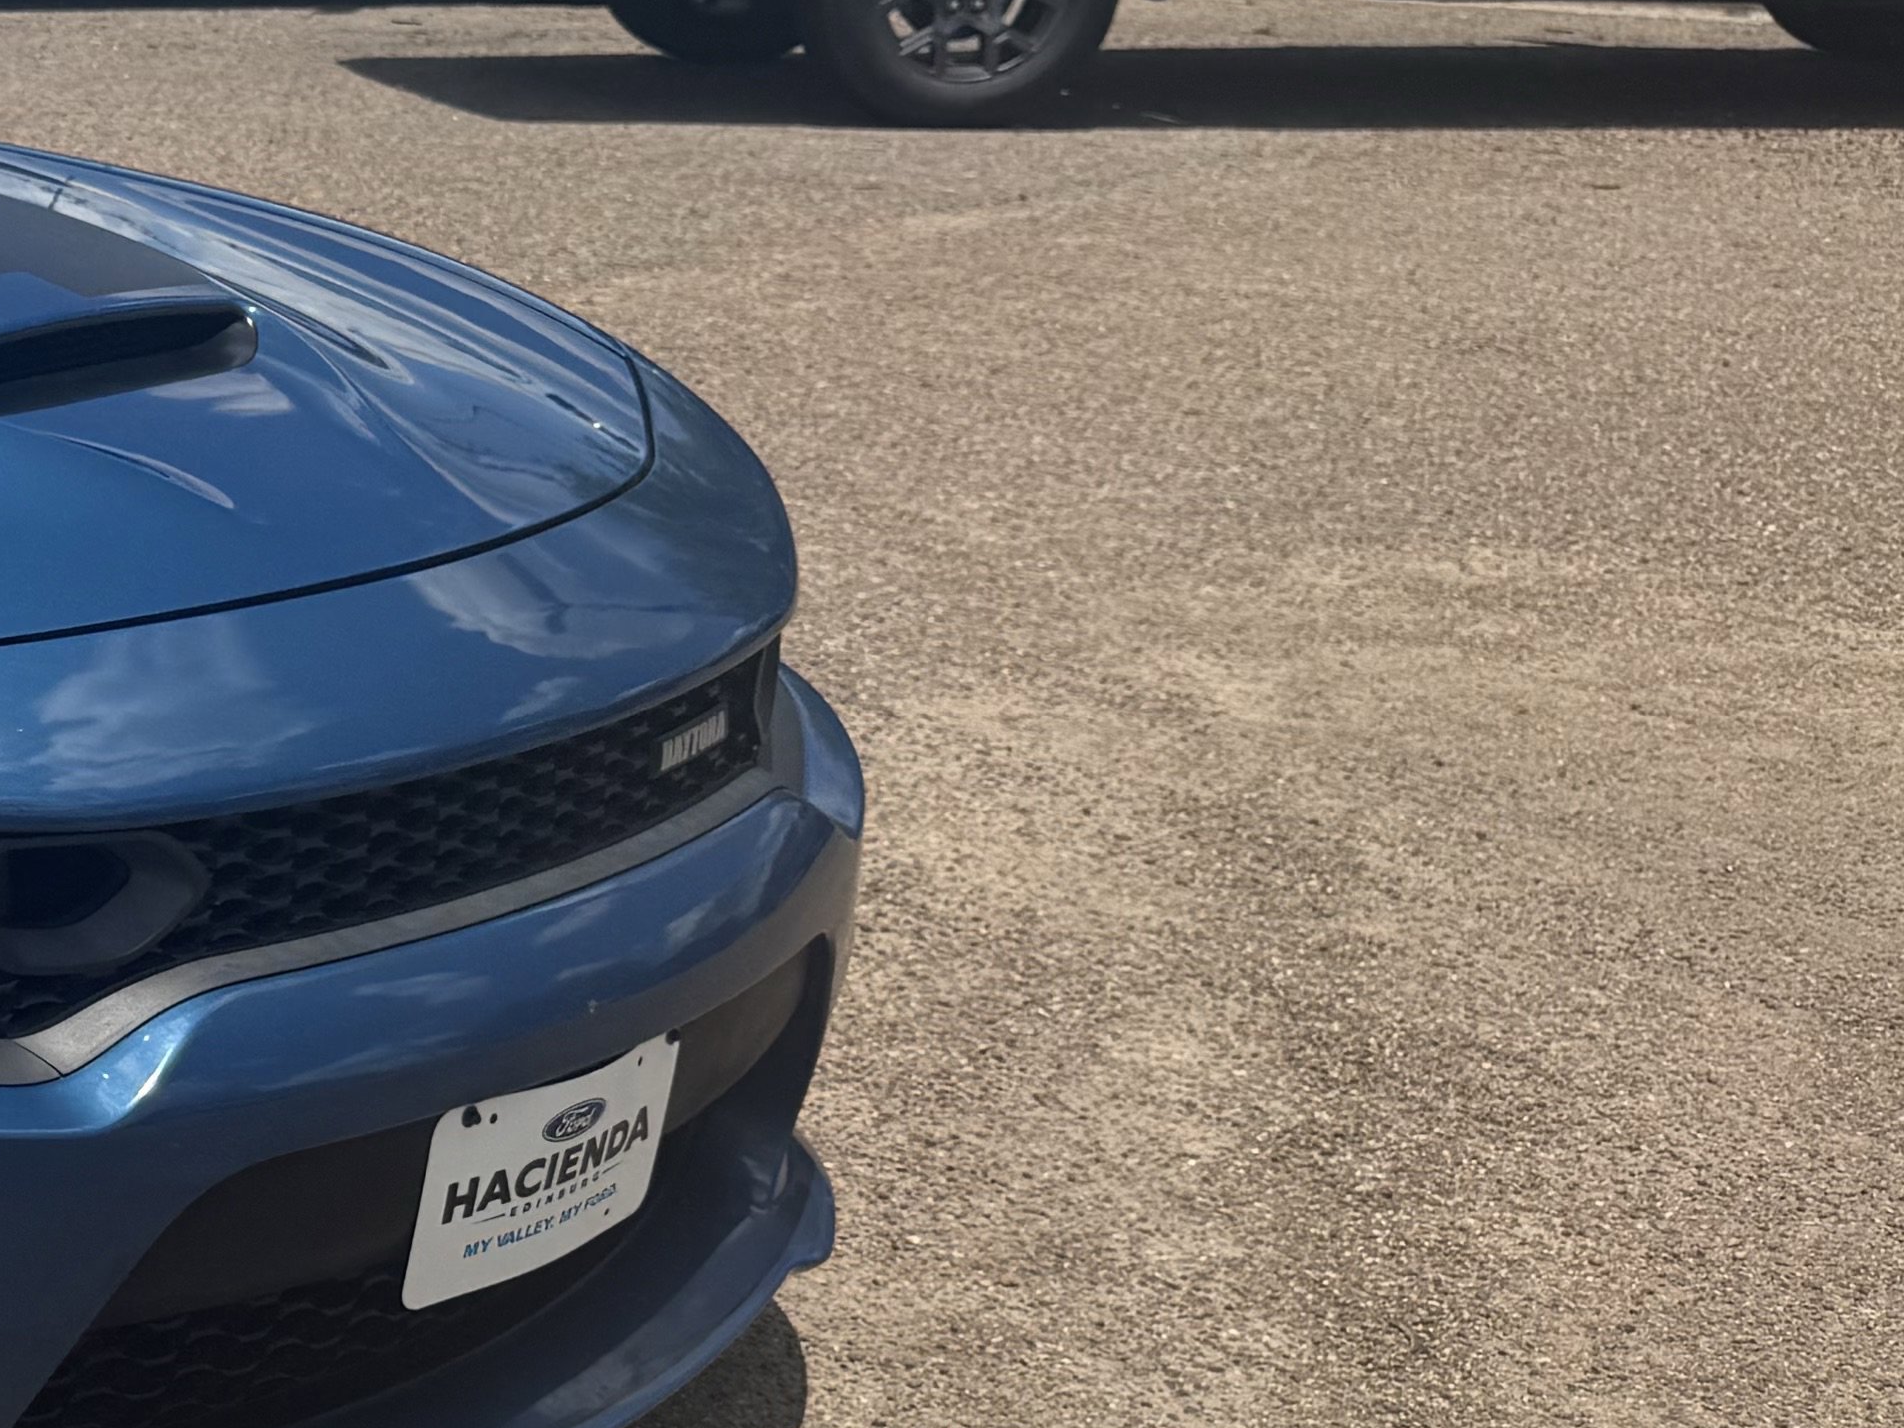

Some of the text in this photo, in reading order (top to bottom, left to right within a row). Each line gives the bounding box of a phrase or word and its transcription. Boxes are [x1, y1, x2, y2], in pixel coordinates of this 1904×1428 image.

[549, 1103, 600, 1139] Ford
[442, 1105, 649, 1225] HACIENDA
[508, 1173, 600, 1218] EDINBURG
[463, 1237, 493, 1259] MY
[558, 1203, 583, 1225] MY
